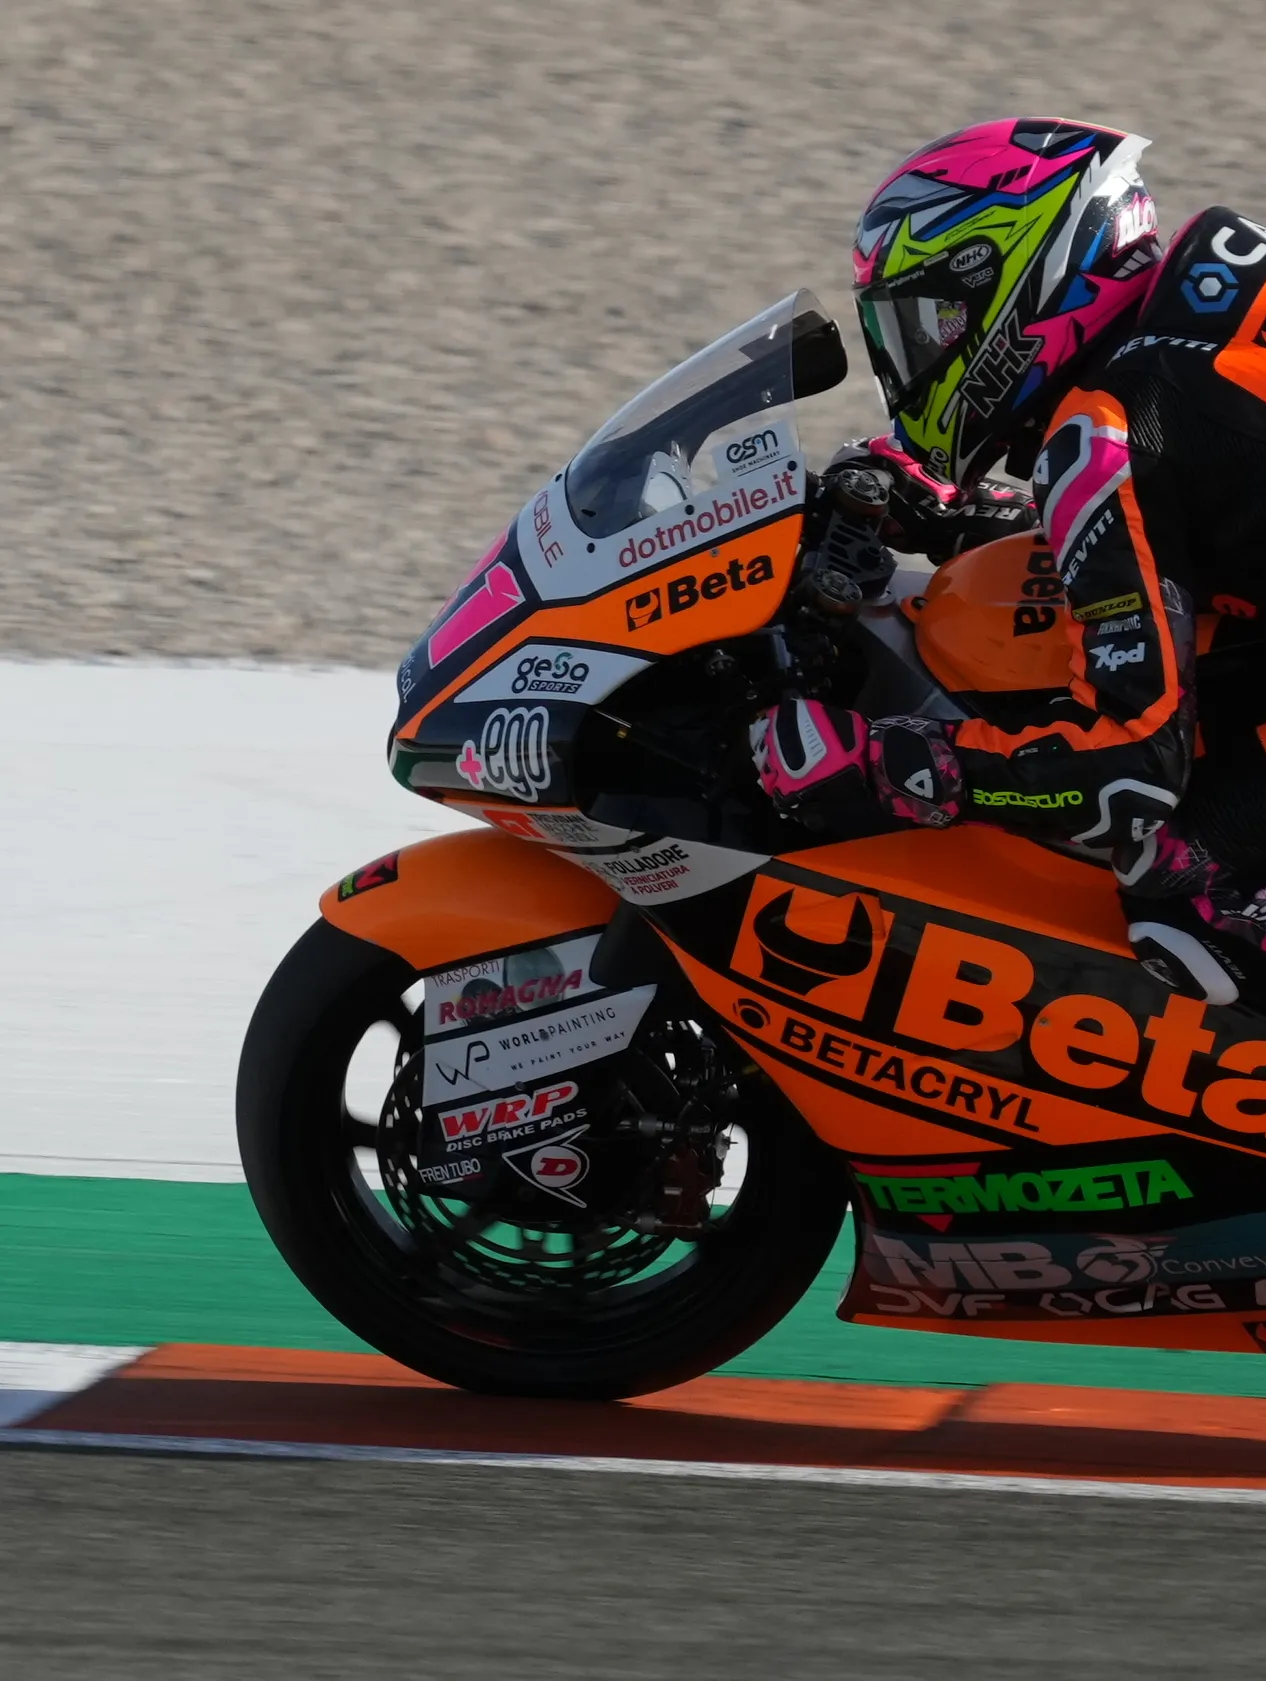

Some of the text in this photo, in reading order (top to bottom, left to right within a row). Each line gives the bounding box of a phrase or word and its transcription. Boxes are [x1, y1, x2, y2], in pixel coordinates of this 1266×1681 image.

[955, 246, 987, 268] NHK
[960, 307, 1043, 419] NHK
[726, 429, 779, 463] esm
[533, 489, 565, 569] OBILE
[618, 471, 798, 569] dotmobile.it
[667, 554, 775, 615] Beta
[511, 651, 590, 694] gesa
[528, 680, 582, 694] SPORTS
[604, 843, 690, 875] FOLLADORE
[637, 879, 680, 895] POLVERI
[431, 960, 501, 988] TRASPORTI
[439, 968, 584, 1025] ROMAGNA
[780, 1015, 1041, 1134] BETACRYL
[438, 1080, 580, 1142] WRP
[446, 1138, 483, 1153] DISC
[539, 1107, 588, 1131] PADS
[418, 1157, 482, 1184] FREN TUBO
[853, 1159, 1195, 1214] TERMOZETA
[872, 1233, 1074, 1290] MB
